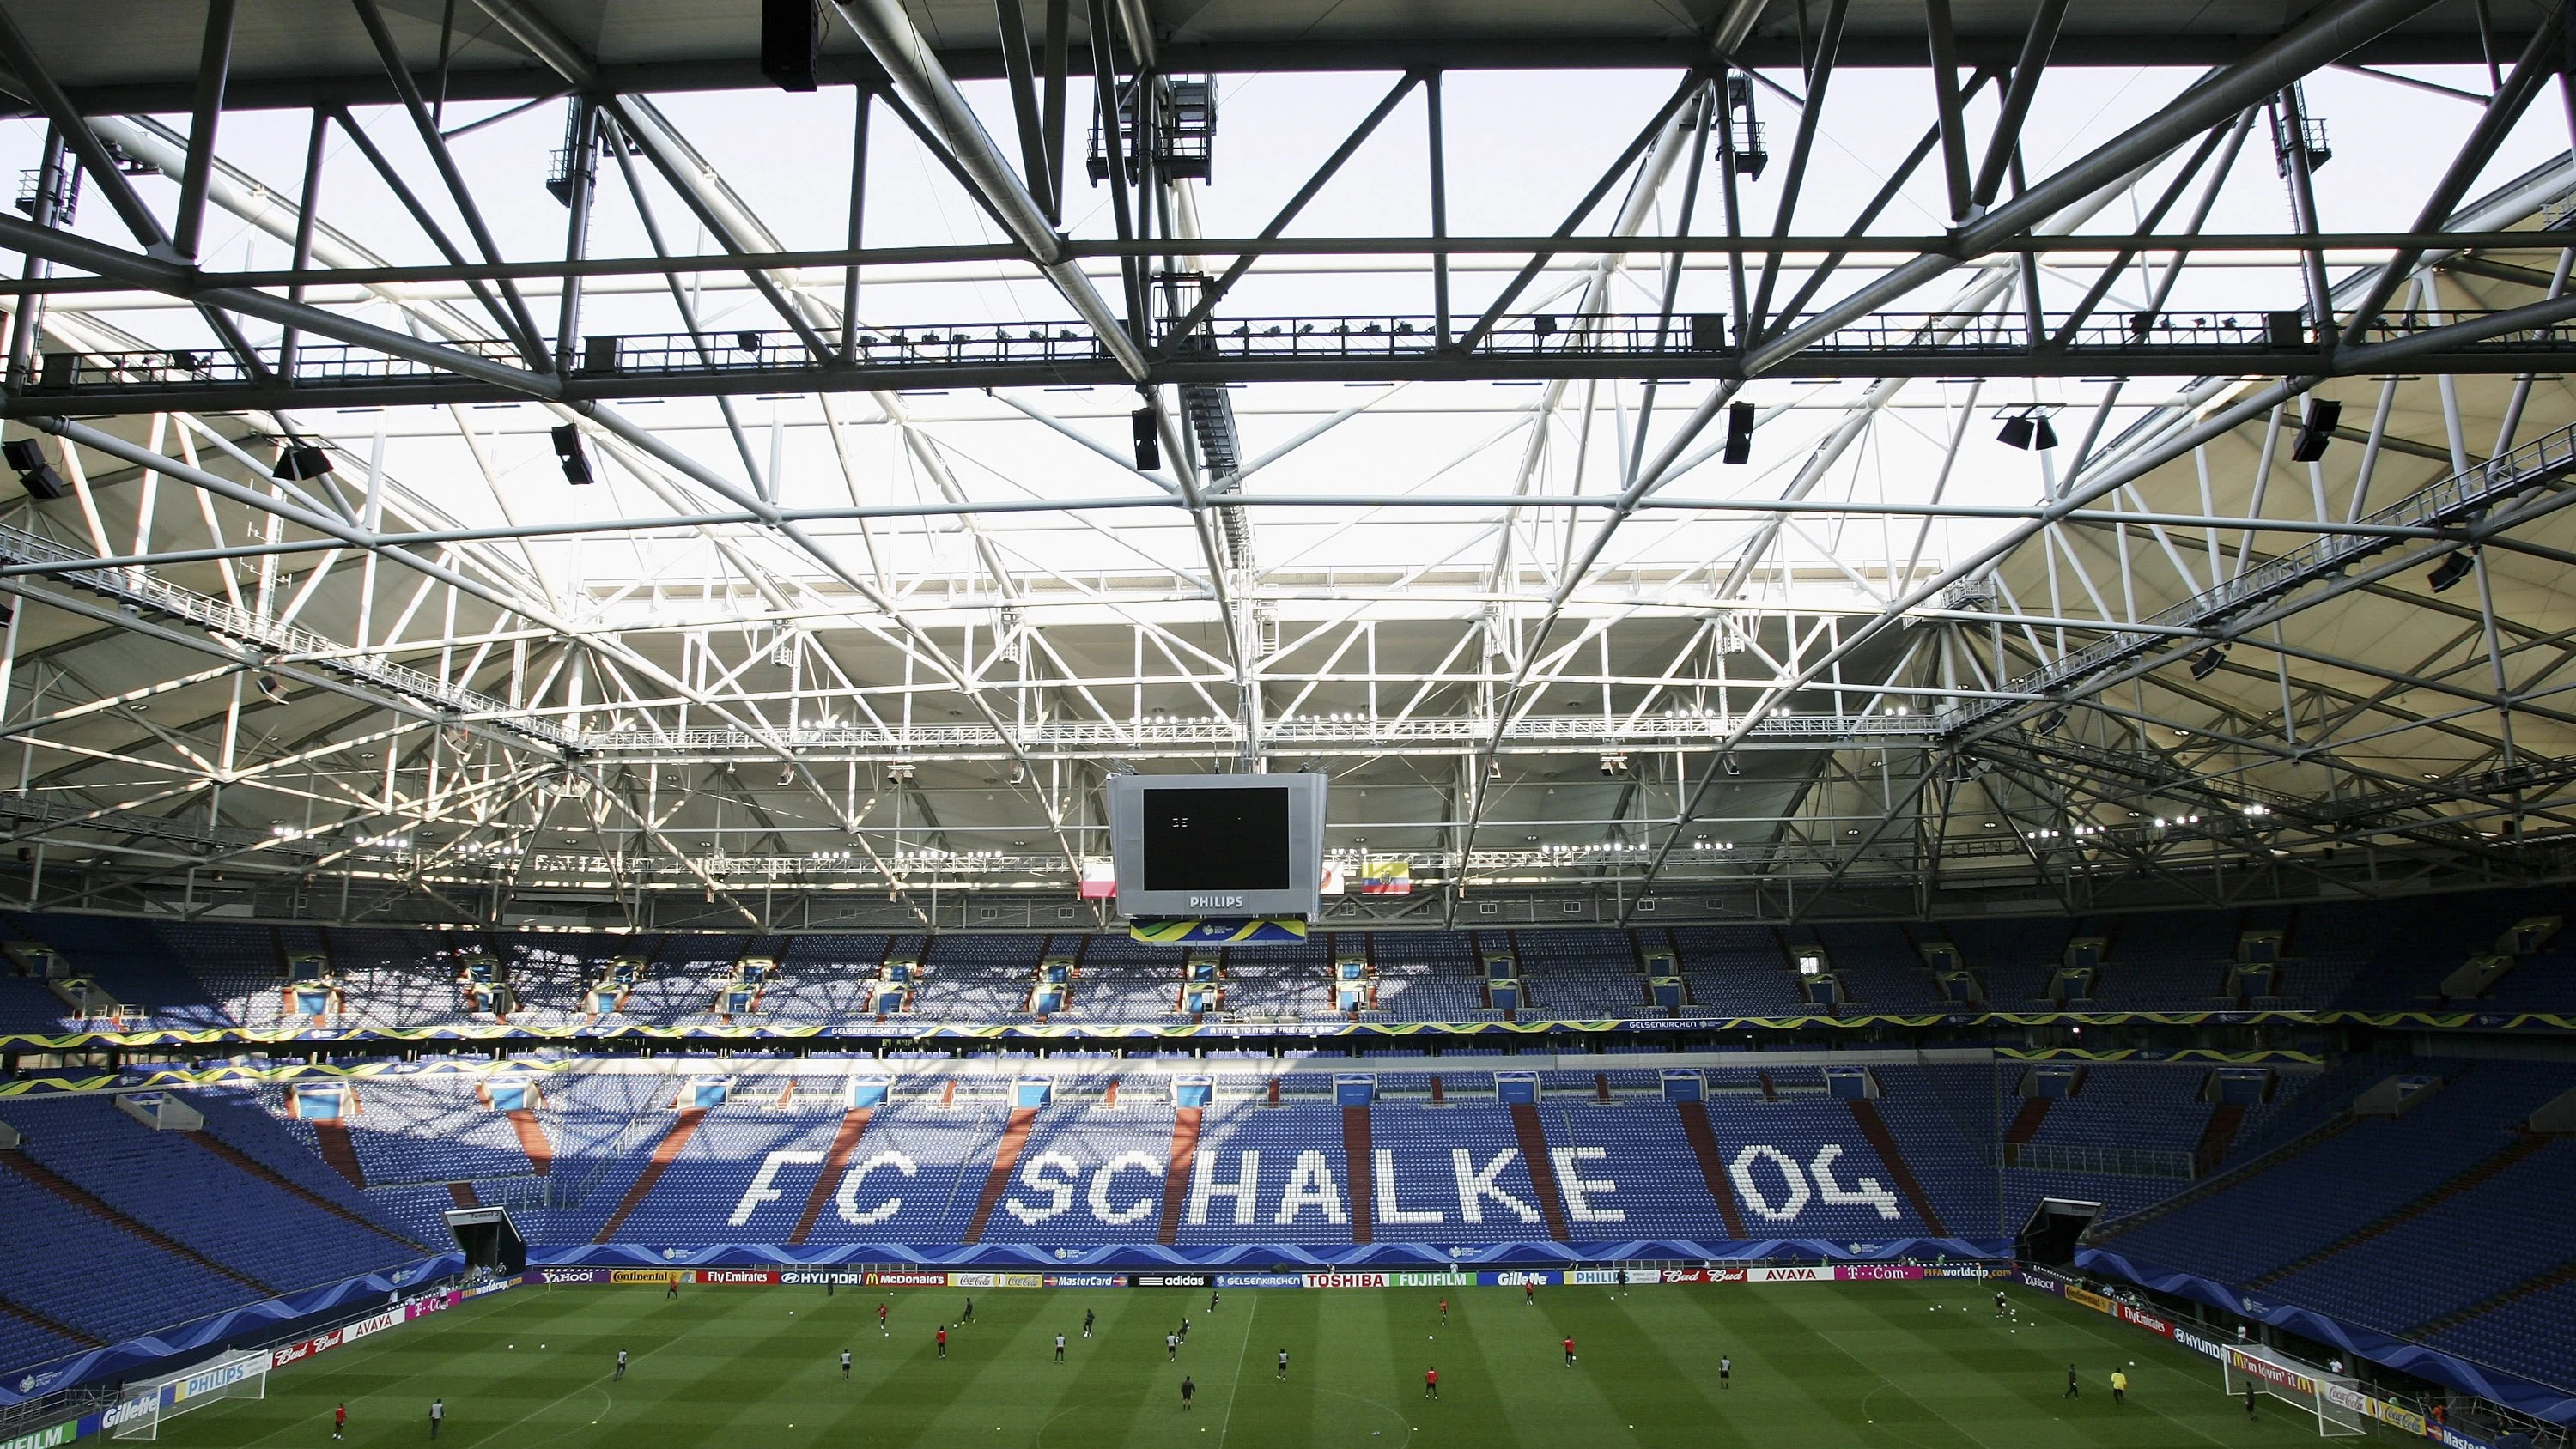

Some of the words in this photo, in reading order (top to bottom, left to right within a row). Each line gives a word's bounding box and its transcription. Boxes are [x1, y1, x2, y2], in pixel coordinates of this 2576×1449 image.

[1189, 896, 1243, 909] PHILIPS
[727, 1149, 918, 1226] FC
[1005, 1145, 1626, 1226] SCHALKE
[1726, 1143, 1901, 1222] 04
[541, 1271, 594, 1284] YAHOO!
[612, 1271, 668, 1282] Continental
[708, 1271, 725, 1284] Fly
[726, 1271, 769, 1282] Emirates
[880, 1275, 945, 1284] McDonald's
[1399, 1273, 1467, 1287] FUJIFILM
[1498, 1272, 1547, 1286] Gillette
[1662, 1270, 1700, 1282] Bud
[1706, 1269, 1744, 1282] Bud
[1765, 1268, 1817, 1281] AVAYA
[1923, 1267, 2012, 1279] FIFAworldcup.com
[1058, 1276, 1113, 1286] MasterCard
[1164, 1276, 1205, 1287] adidas
[1227, 1277, 1301, 1286] GELSENKIRCHEN
[1307, 1274, 1385, 1288] TOSHIBA
[2021, 1272, 2056, 1291] YAHOO!
[2066, 1286, 2100, 1307] Continental
[355, 1313, 392, 1337] AVAYA
[2123, 1307, 2136, 1324] Fly
[2136, 1311, 2166, 1333] Emirates
[275, 1344, 309, 1366] Bud
[313, 1331, 343, 1353] Bud
[188, 1362, 245, 1396] PHILIPS
[2287, 1373, 2297, 1388] it
[102, 1395, 159, 1429] Gillette
